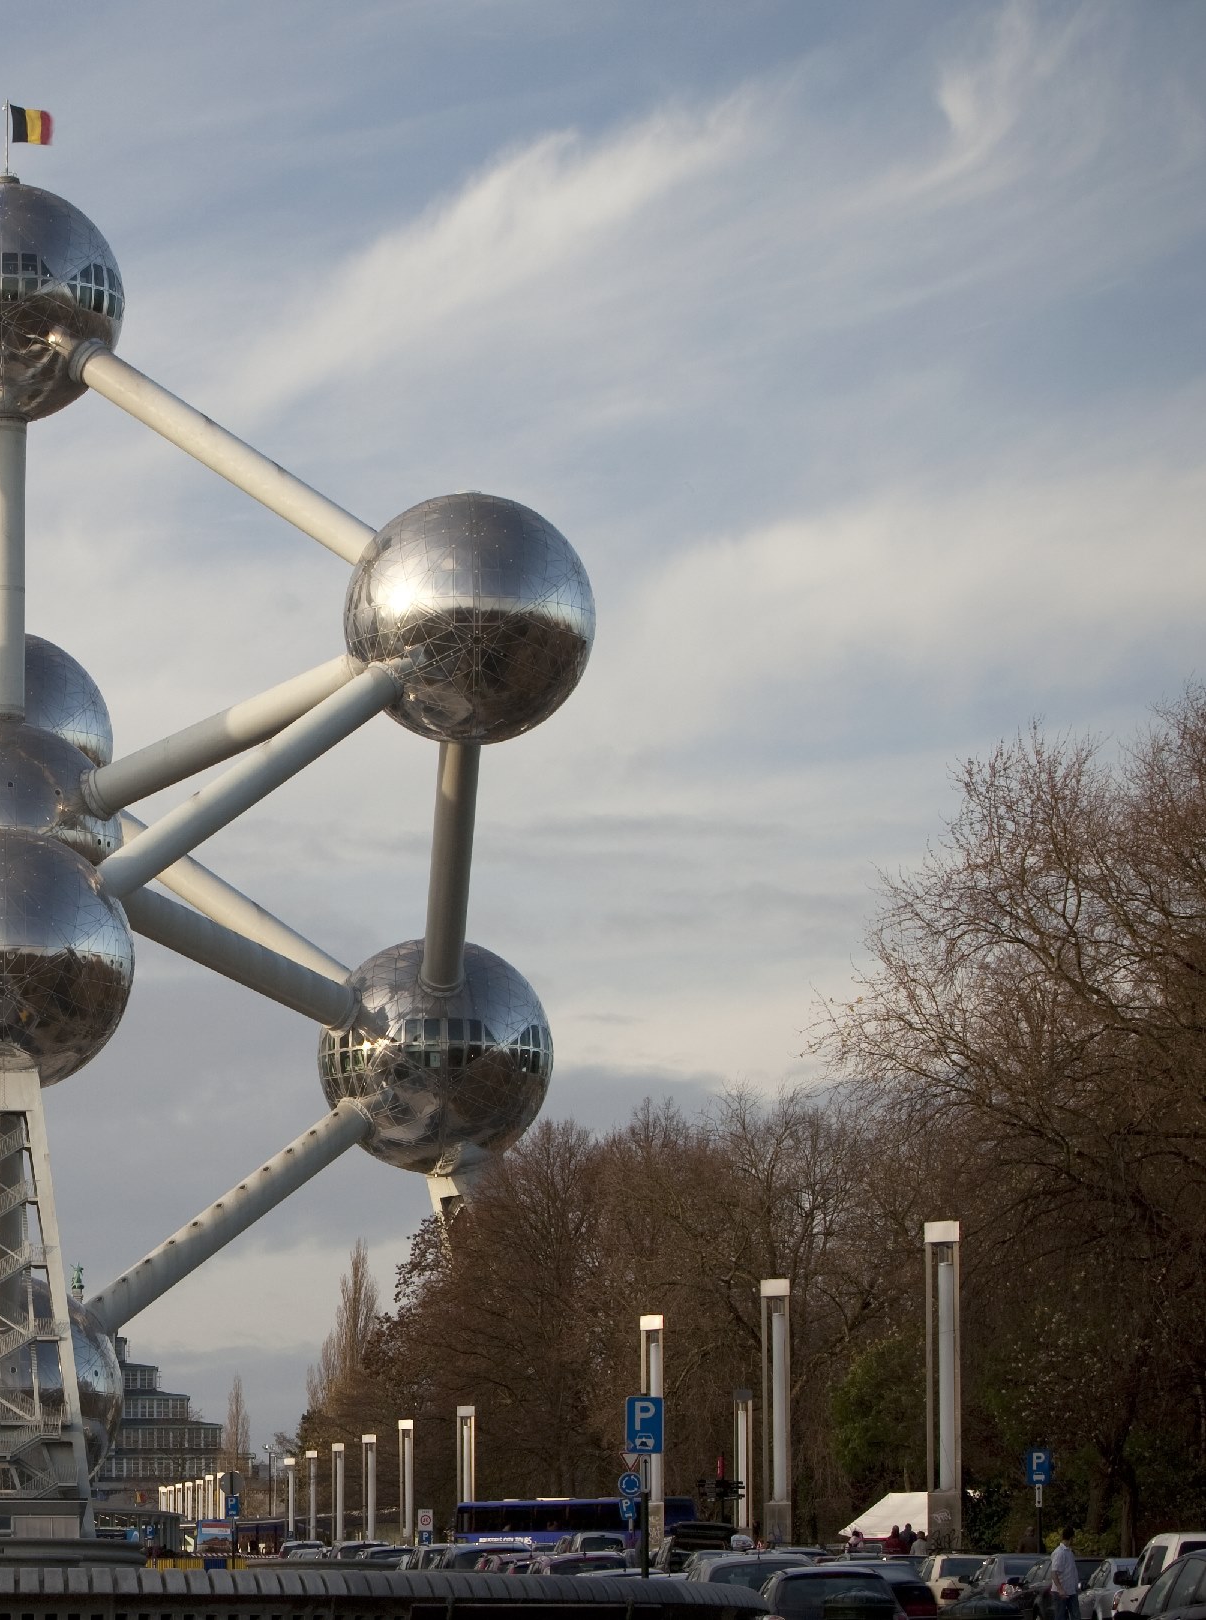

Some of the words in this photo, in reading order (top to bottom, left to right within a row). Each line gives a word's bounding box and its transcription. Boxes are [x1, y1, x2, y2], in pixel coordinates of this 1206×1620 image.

[634, 1401, 656, 1431] P
[1032, 1452, 1046, 1471] P
[228, 1497, 236, 1508] P
[622, 1499, 631, 1511] P
[146, 1525, 153, 1535] P
[422, 1532, 429, 1541] P
